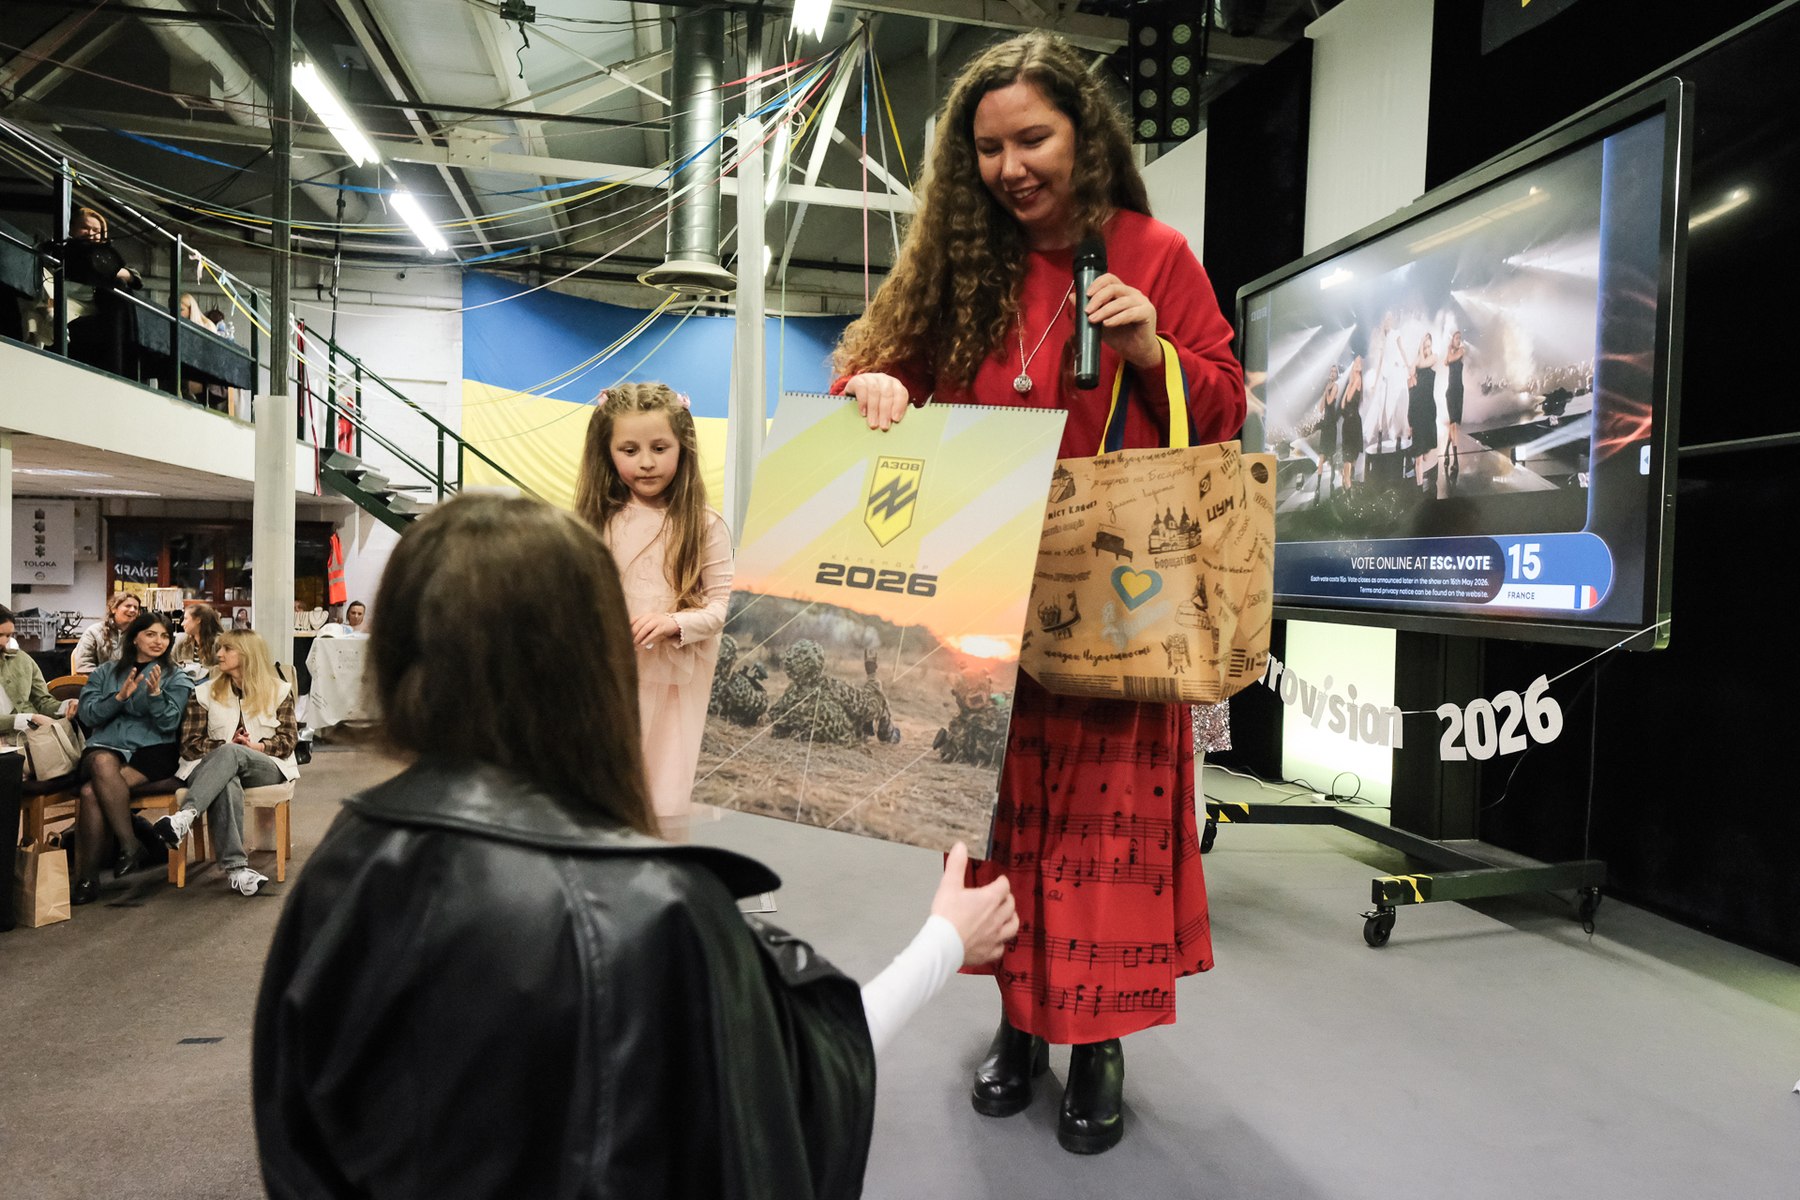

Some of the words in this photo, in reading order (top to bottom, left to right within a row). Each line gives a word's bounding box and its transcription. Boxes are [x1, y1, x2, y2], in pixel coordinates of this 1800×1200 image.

[1206, 495, 1234, 522] ЦУМ
[24, 560, 57, 568] TOLOKA
[1351, 556, 1375, 570] VOTE
[1376, 556, 1412, 570] ONLINE
[1414, 556, 1428, 570] AT
[1429, 555, 1490, 571] ESC.VOTE
[1508, 543, 1541, 580] 15
[815, 562, 938, 598] 2026
[1377, 576, 1402, 584] announced
[1420, 577, 1428, 585] the
[1428, 577, 1441, 585] show
[1462, 578, 1473, 587] May
[1360, 586, 1372, 594] Terms
[1382, 588, 1399, 596] privacy
[1399, 588, 1414, 596] notice
[1424, 588, 1431, 596] be
[1431, 589, 1447, 597] found
[1455, 589, 1465, 597] the
[1507, 591, 1535, 600] FRANCE
[1258, 652, 1403, 749] rovision
[1435, 673, 1564, 761] 2026
